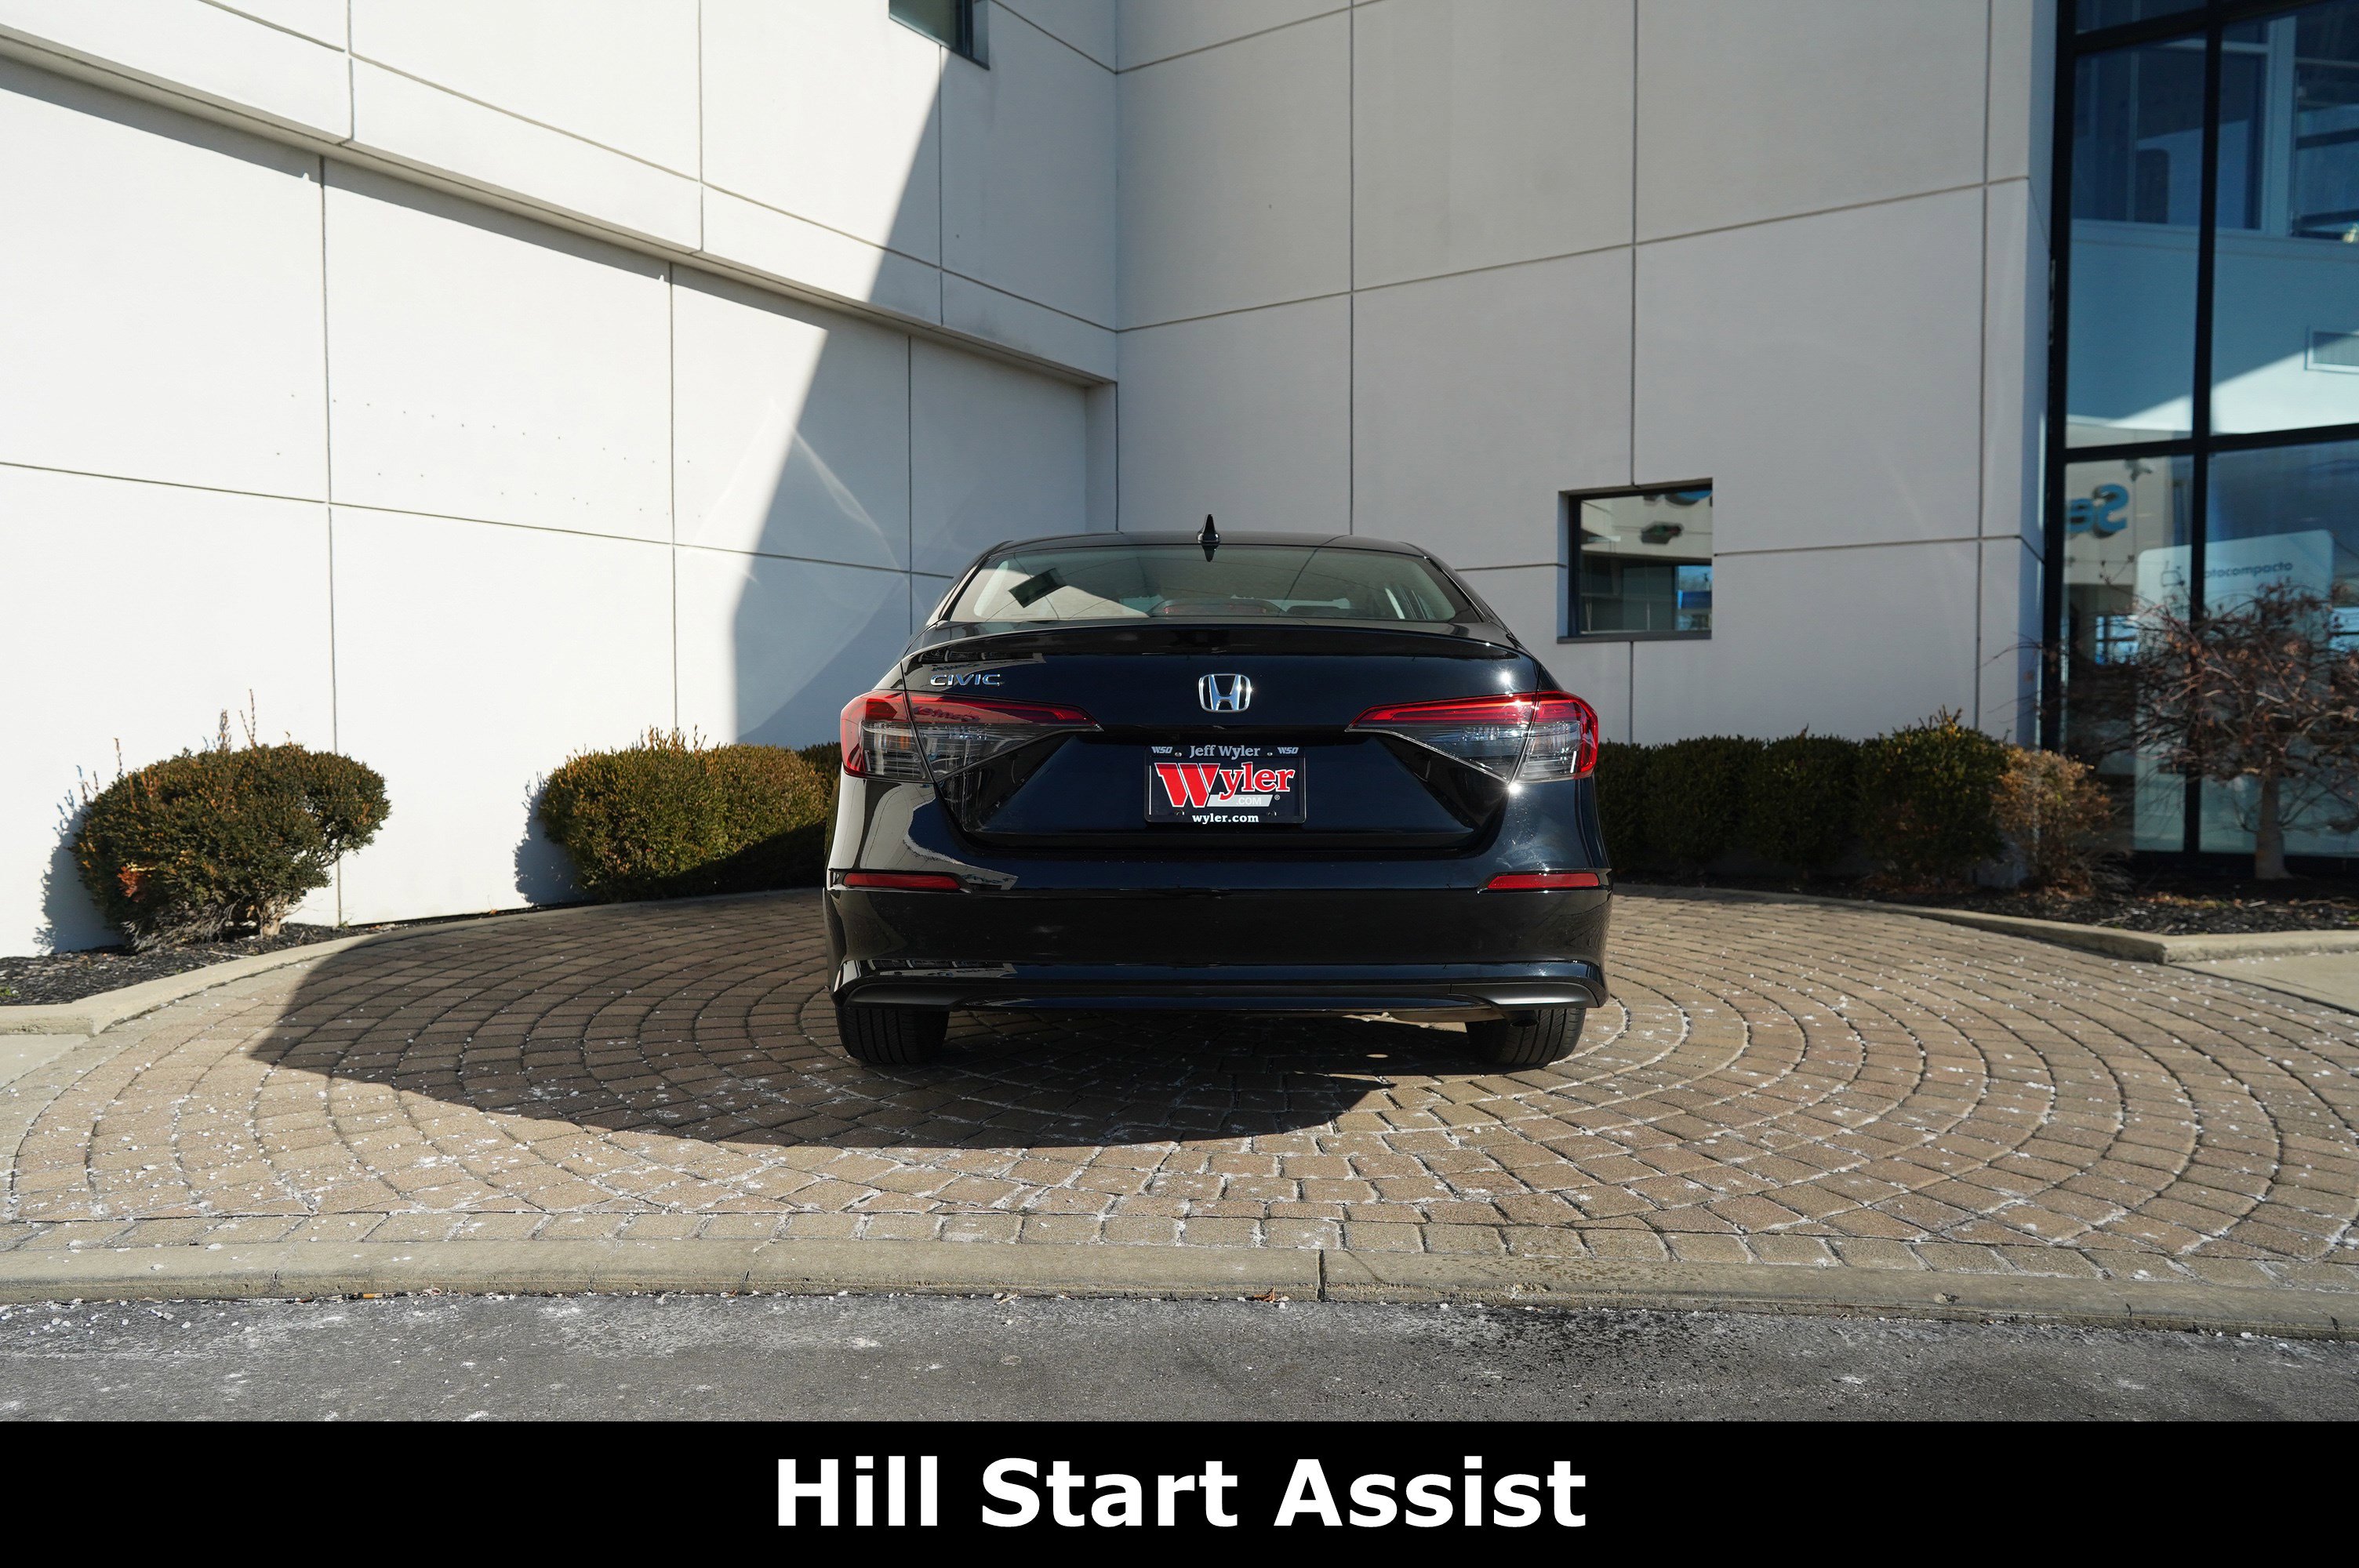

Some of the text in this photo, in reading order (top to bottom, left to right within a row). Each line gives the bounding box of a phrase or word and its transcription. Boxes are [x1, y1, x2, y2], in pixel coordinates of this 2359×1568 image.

[930, 673, 1000, 686] CIVIC
[1189, 745, 1261, 760] Jeff Wyler
[1154, 761, 1296, 808] Wyler
[1192, 813, 1259, 825] wyler.com
